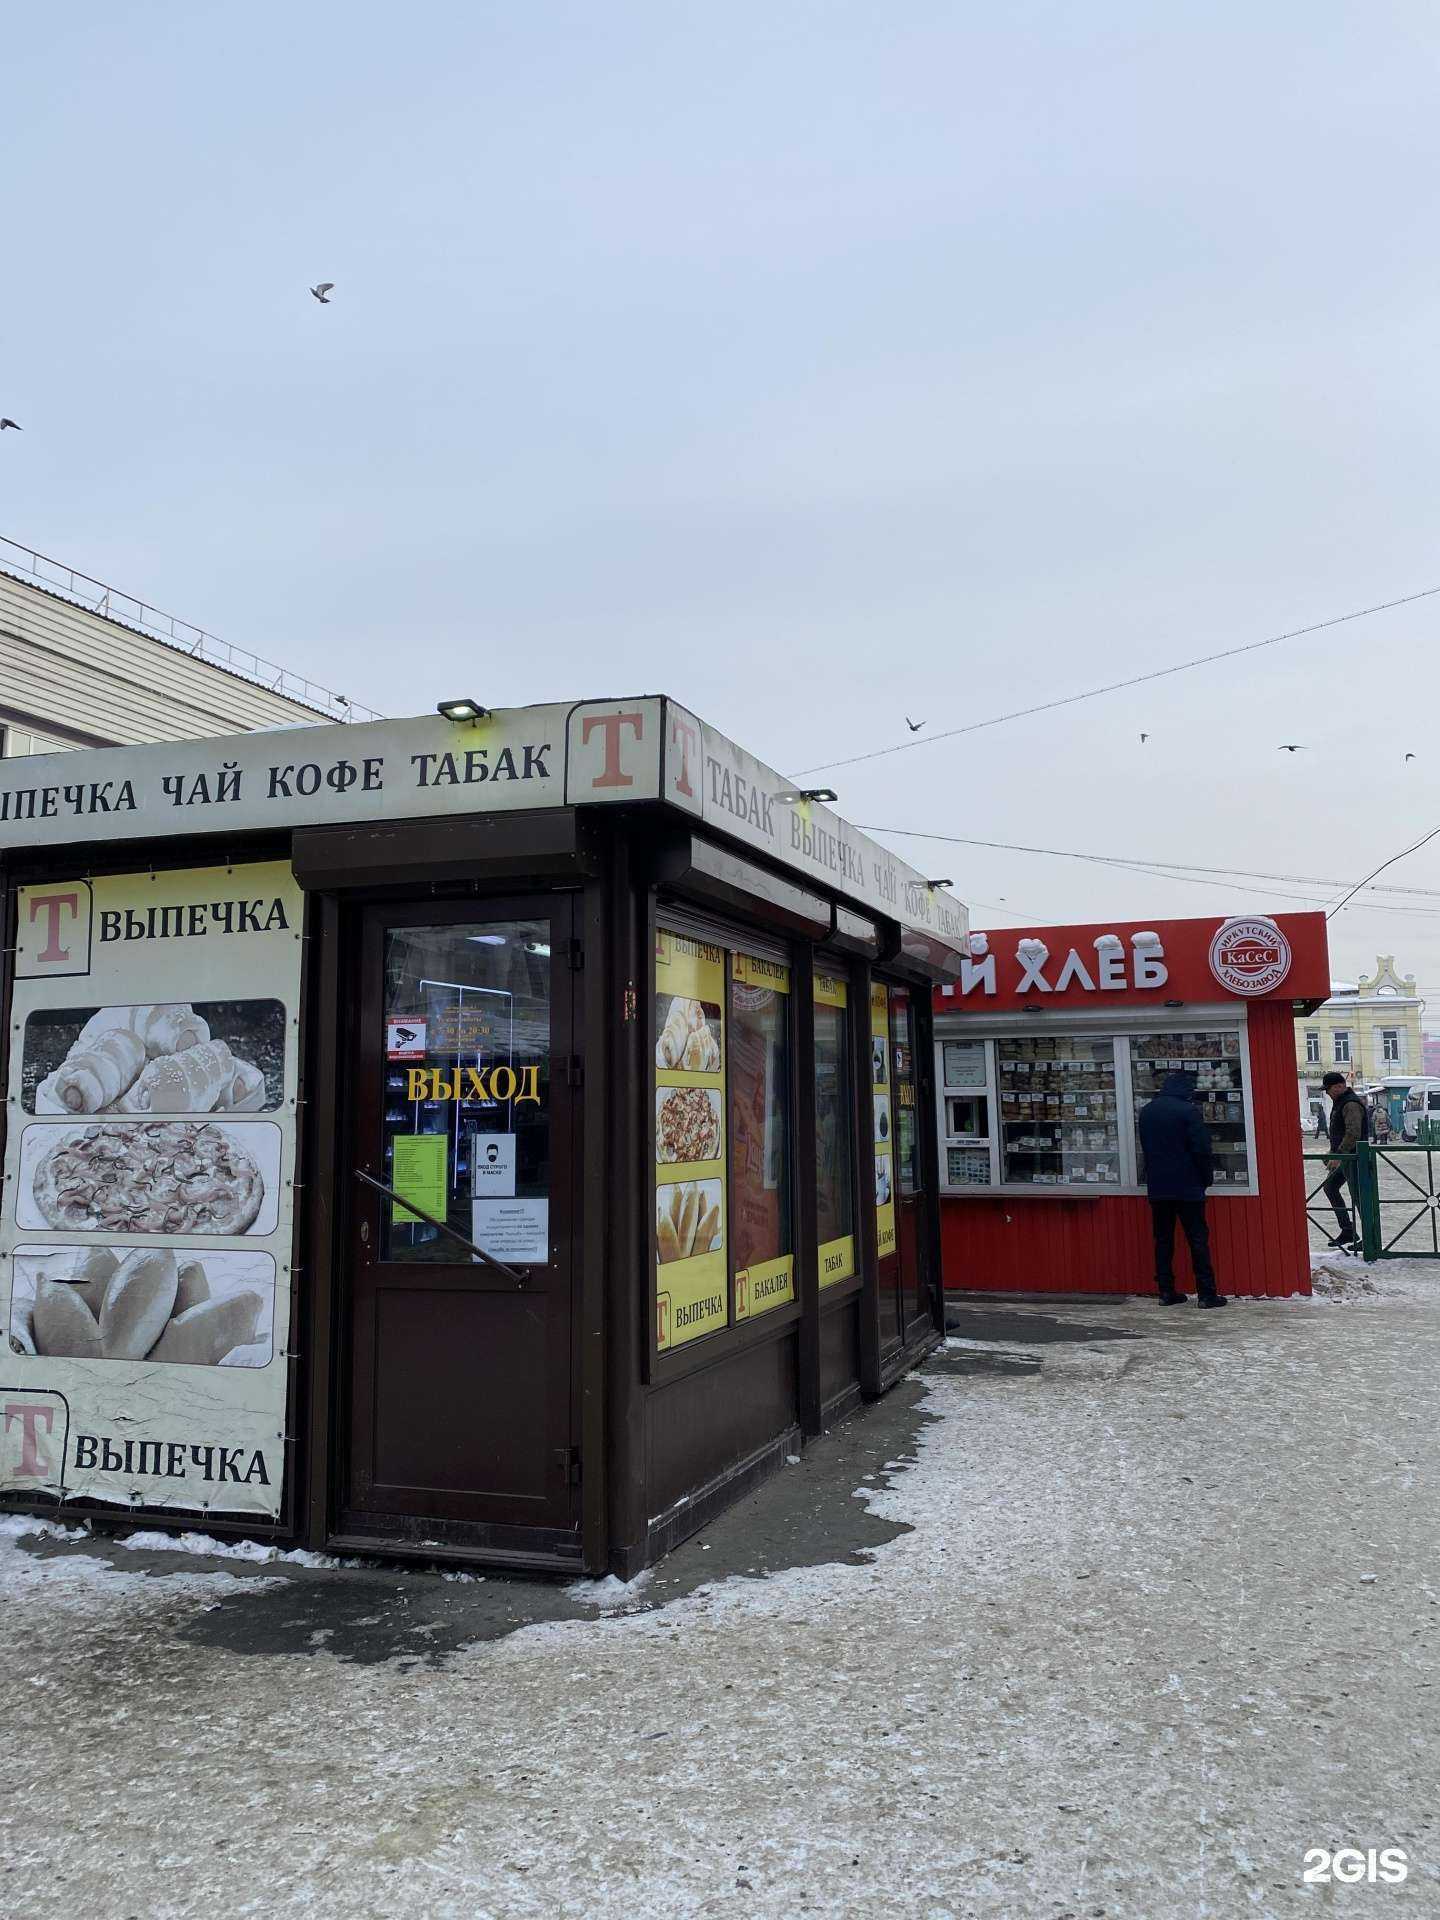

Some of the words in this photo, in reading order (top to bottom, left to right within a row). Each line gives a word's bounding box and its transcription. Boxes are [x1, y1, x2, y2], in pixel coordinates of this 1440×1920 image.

[582, 713, 643, 789] Т
[673, 721, 697, 798] Т
[0, 780, 137, 821] ПЕЧКА
[162, 761, 244, 807] ЧАЙ
[266, 757, 385, 799] КОФЕ
[411, 744, 552, 788] ТАБАК
[707, 756, 775, 838] ТАБАК
[790, 809, 865, 887] ВЫПЕЧКА
[873, 862, 897, 905] ЧАЙ
[30, 893, 78, 962] Т
[99, 898, 290, 942] ВЫПЕЧКА
[1221, 926, 1277, 948] ИРКУТСКИЙ
[942, 933, 997, 996] Й
[1015, 935, 1169, 993] ХЛЕБ
[1222, 968, 1282, 989] ХЛЕБОЗАВОД
[406, 1066, 541, 1107] ВЫХОД
[754, 1271, 789, 1300] БАКАЛЕЯ
[825, 1253, 844, 1273] ТАБАК
[676, 1294, 723, 1329] ВЫПЕЧКА
[737, 1276, 747, 1314] Т
[4, 1404, 54, 1477] Т
[74, 1434, 272, 1486] ВЫПЕЧКА
